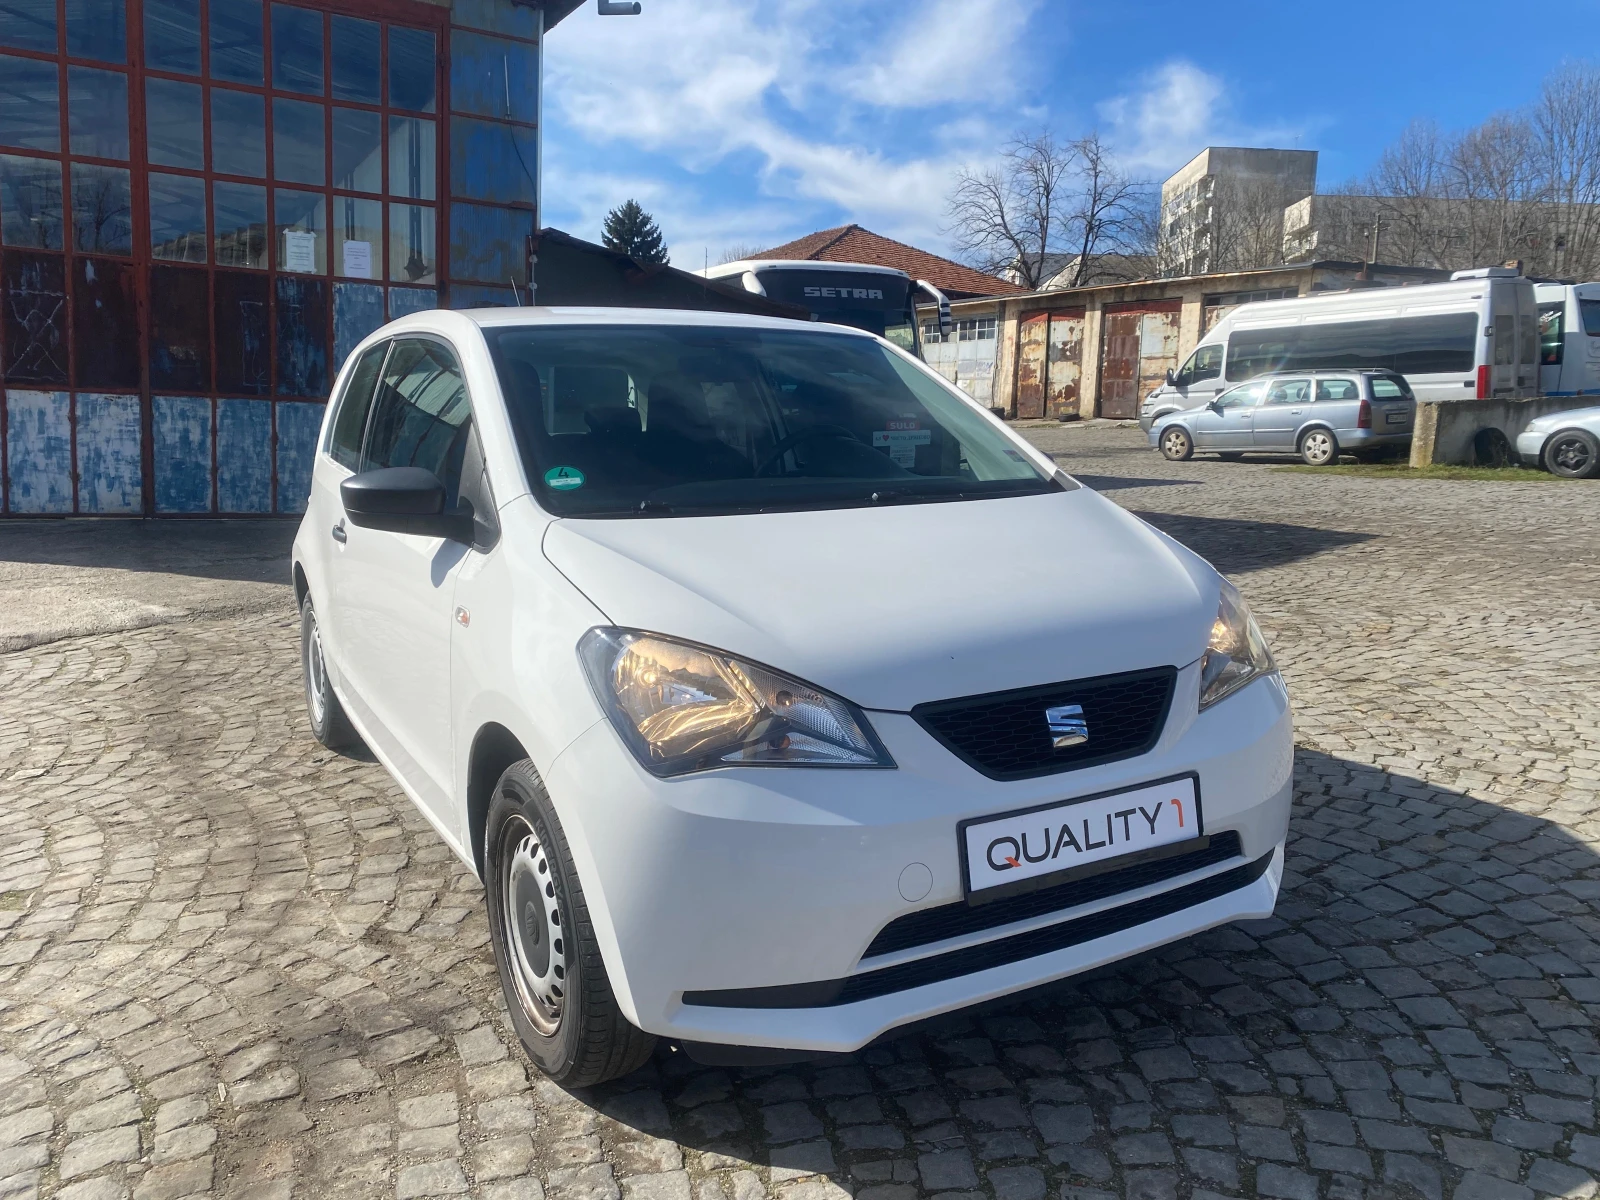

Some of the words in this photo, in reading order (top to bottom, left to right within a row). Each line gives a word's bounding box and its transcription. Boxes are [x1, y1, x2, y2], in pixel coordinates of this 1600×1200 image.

[804, 286, 884, 300] SETRA
[890, 422, 916, 430] SULO
[557, 467, 570, 479] 4
[986, 801, 1164, 872] QUALITY
[1170, 798, 1184, 828] 1
